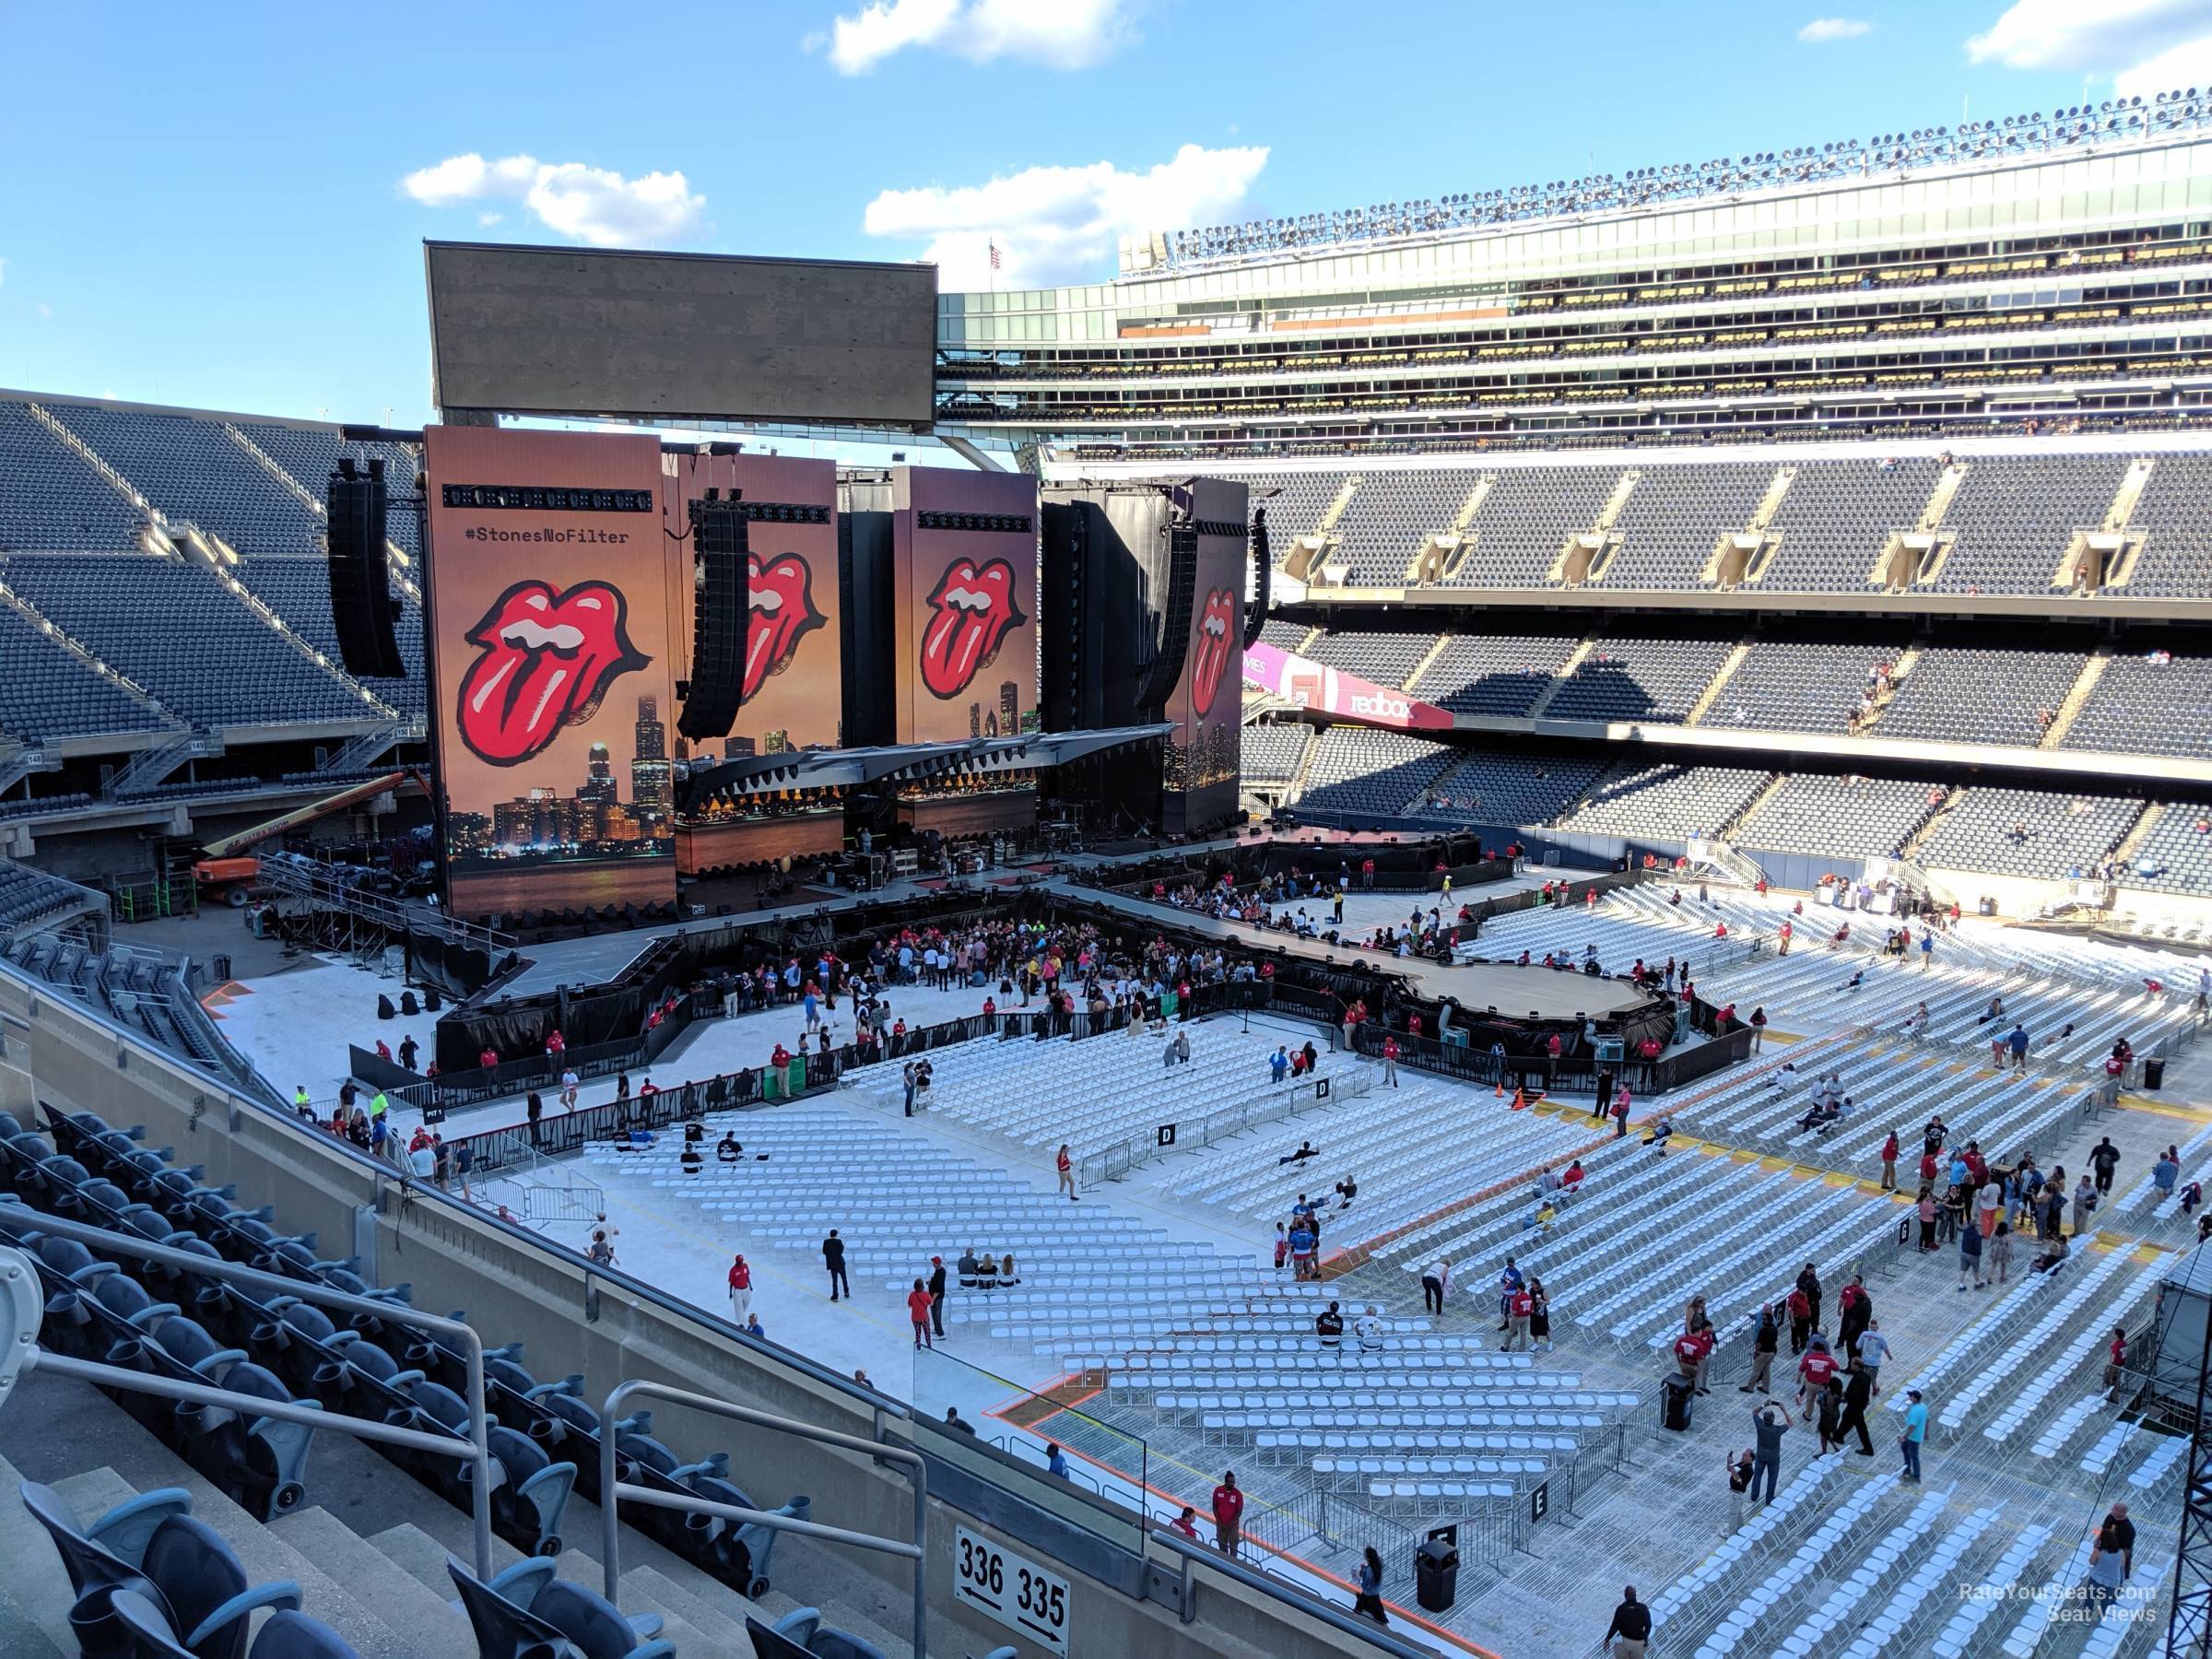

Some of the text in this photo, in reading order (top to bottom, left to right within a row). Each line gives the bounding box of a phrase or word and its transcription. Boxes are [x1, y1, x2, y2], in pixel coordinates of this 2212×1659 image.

[465, 527, 629, 544] #StonesNoFilter
[1349, 691, 1415, 719] redbox
[1319, 1082, 1325, 1095] D
[1162, 1128, 1171, 1142] D
[1901, 1222, 1908, 1240] G
[286, 1491, 292, 1503] 3
[1535, 1489, 1545, 1515] E
[959, 1537, 1004, 1595] 336
[1018, 1568, 1065, 1628] 335
